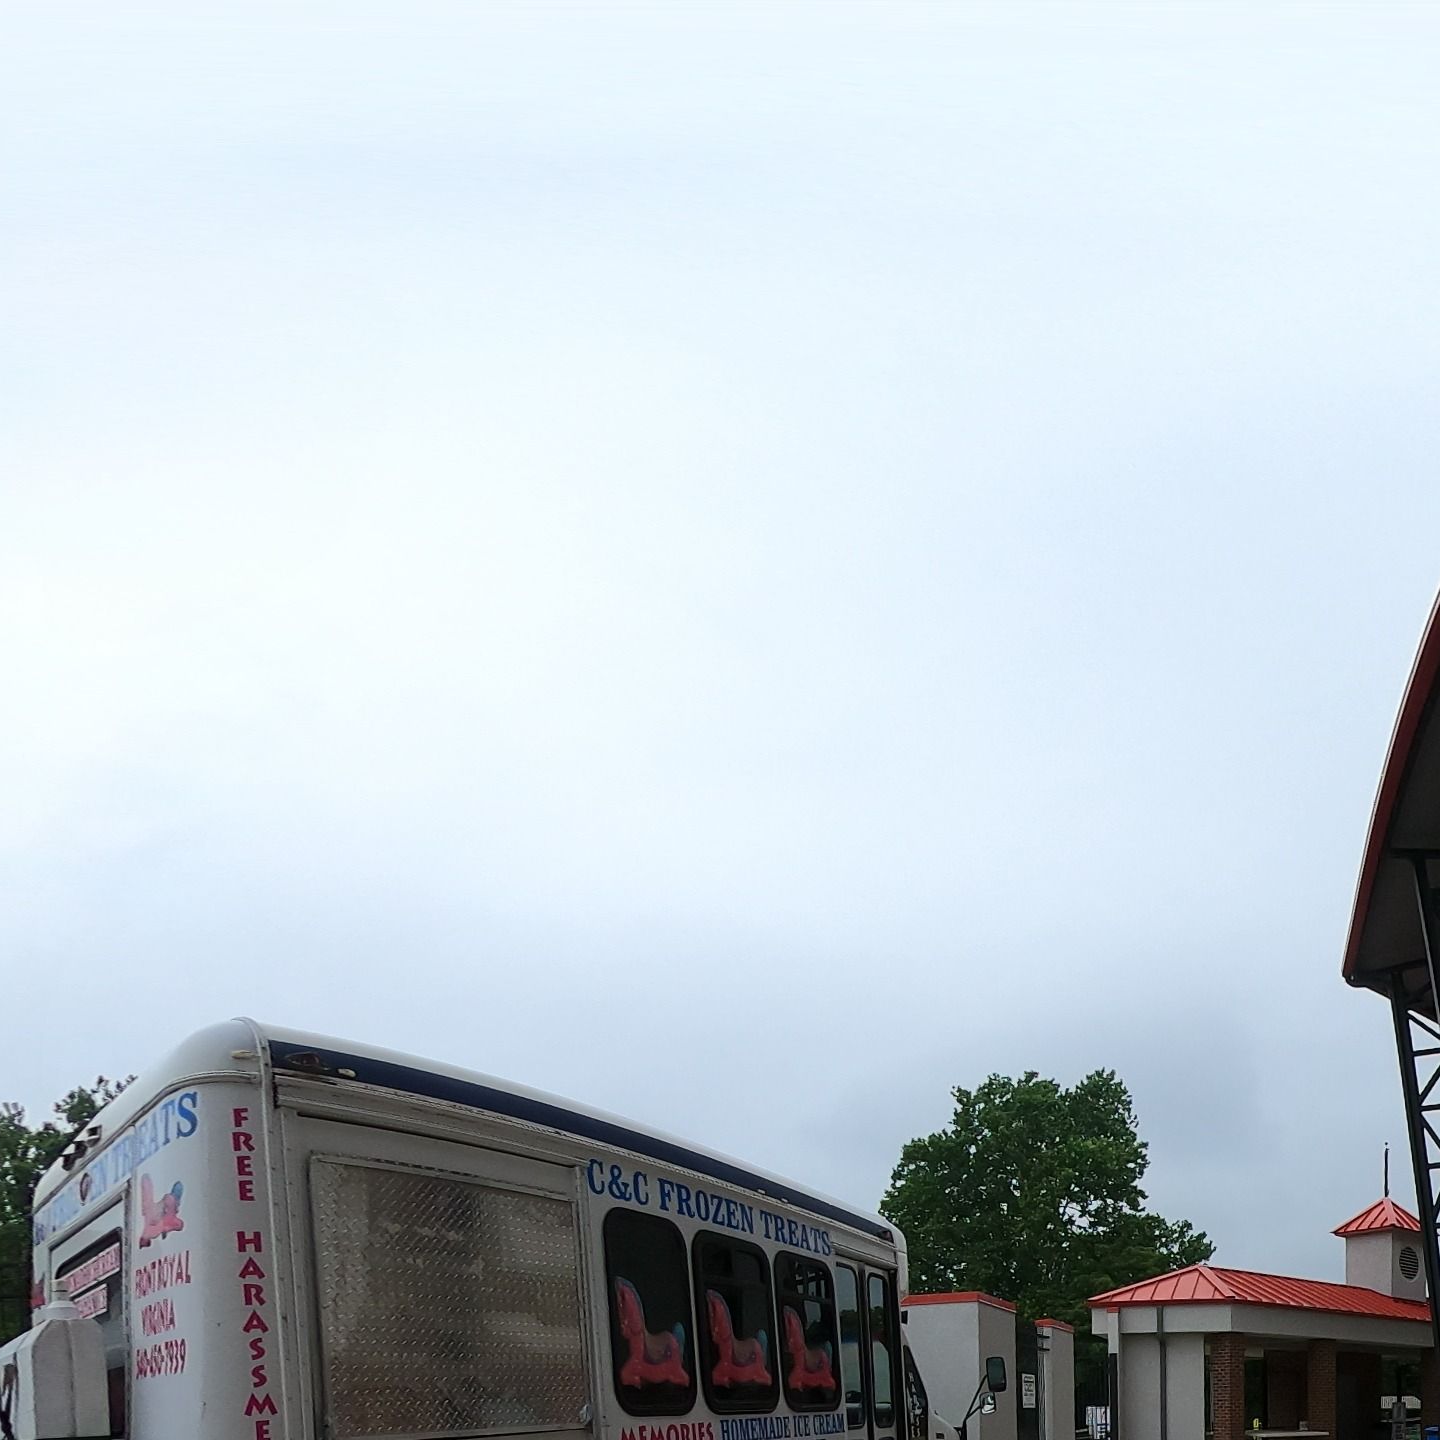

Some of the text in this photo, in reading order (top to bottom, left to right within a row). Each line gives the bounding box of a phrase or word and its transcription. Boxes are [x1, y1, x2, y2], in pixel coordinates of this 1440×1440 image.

[232, 1107, 256, 1201] FREE
[587, 1158, 833, 1257] C&C FROZEN TREATS
[157, 1250, 192, 1290] ROYAL
[792, 1415, 810, 1438] ICE
[813, 1413, 846, 1435] CREAM
